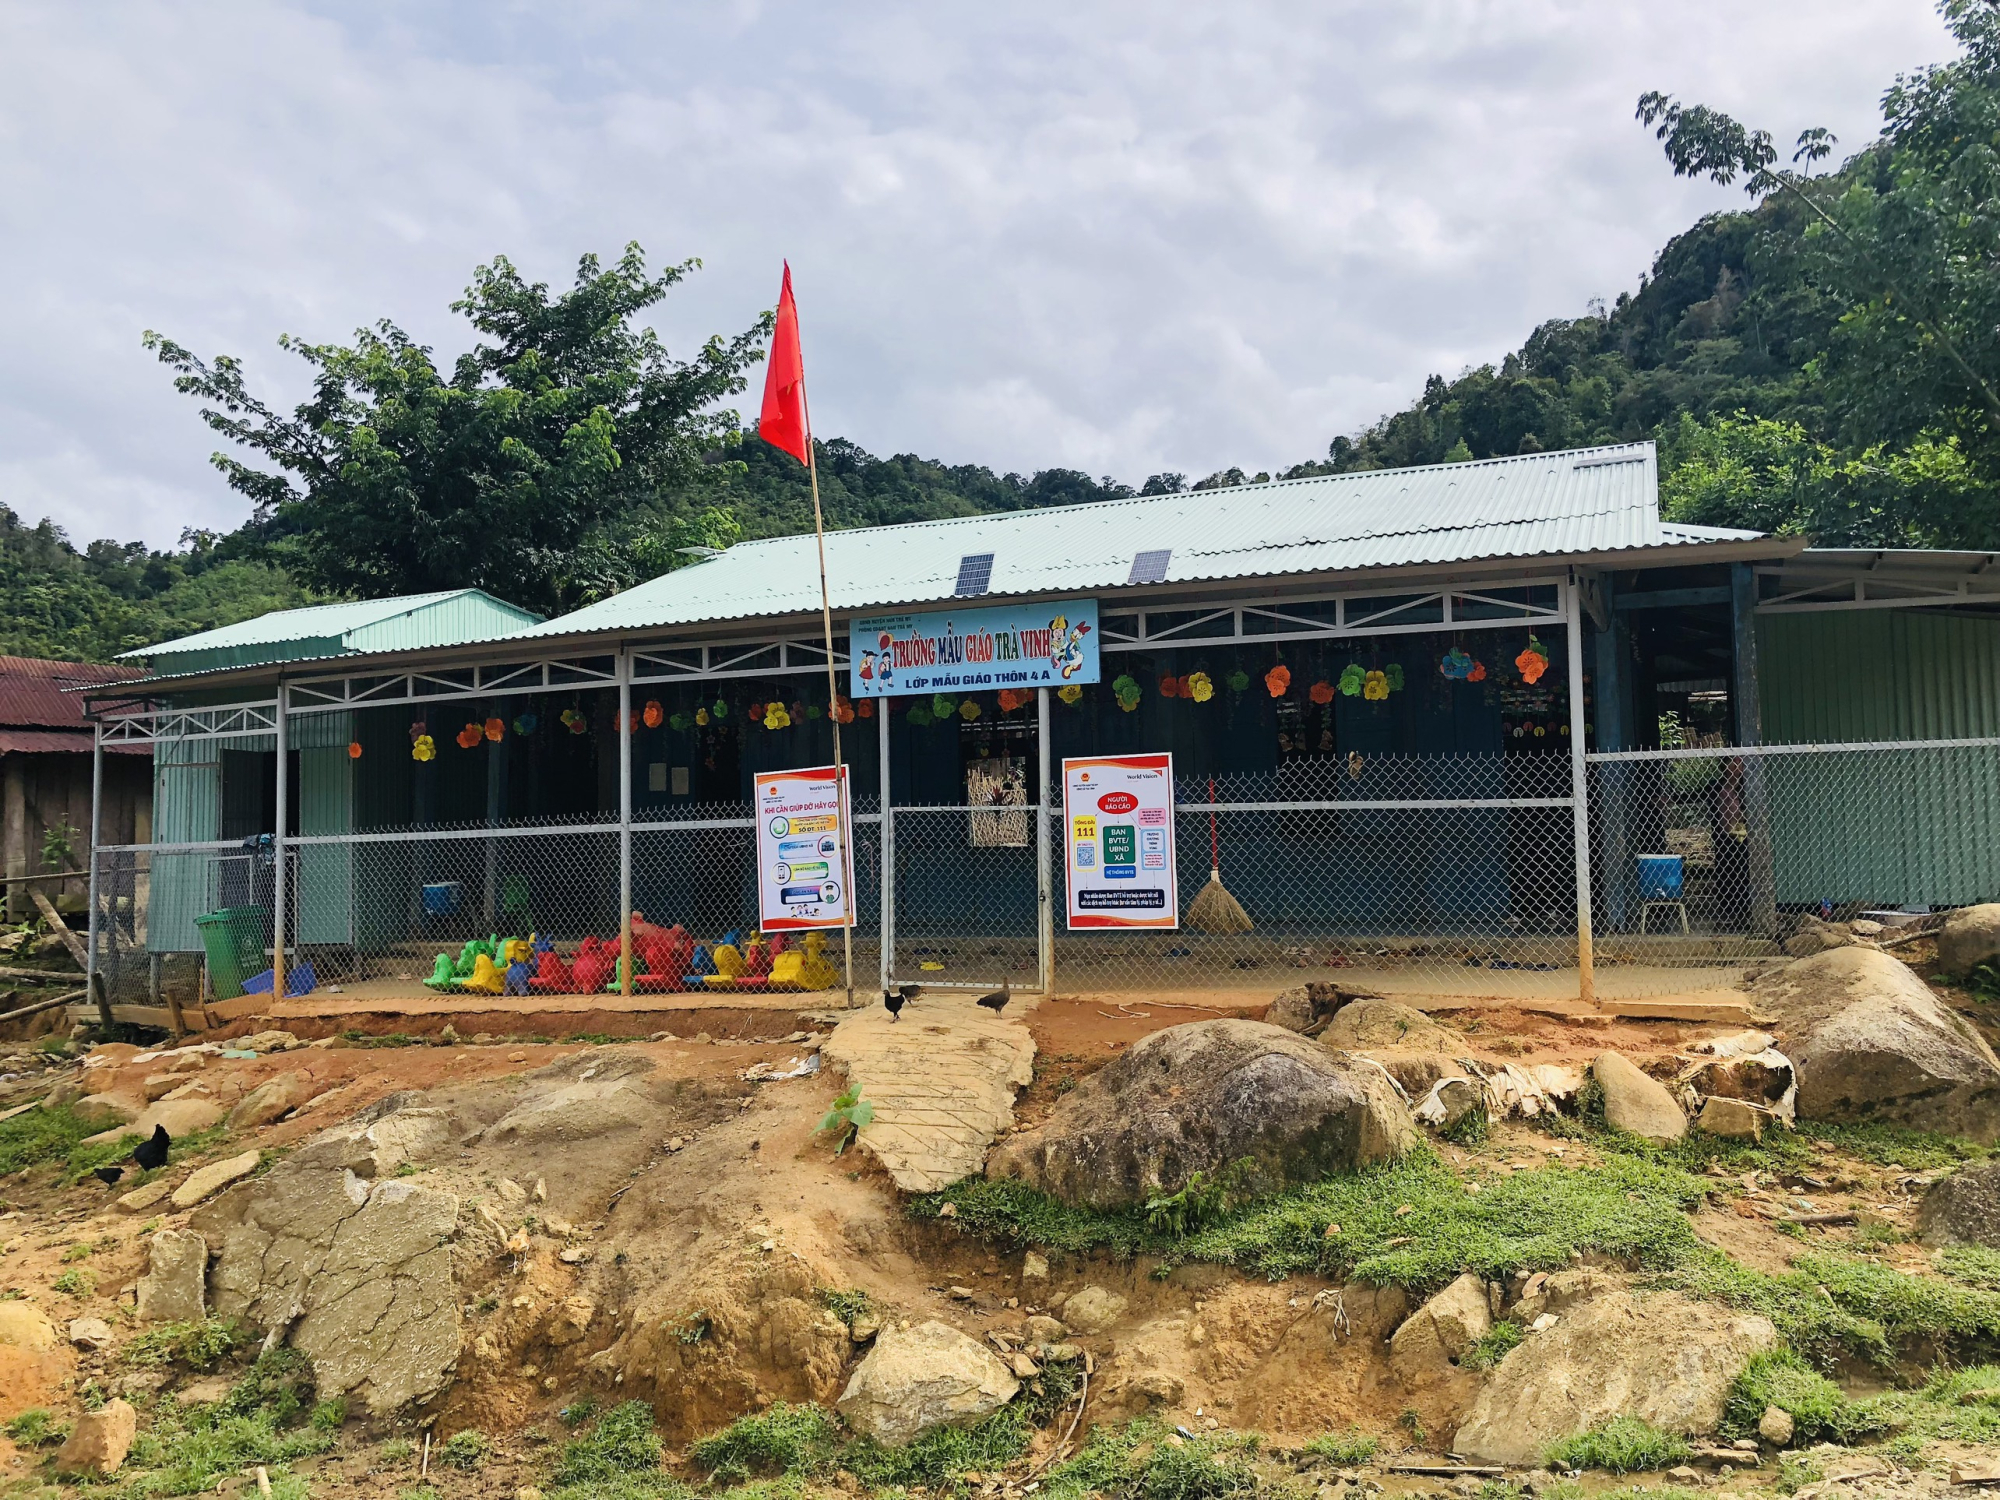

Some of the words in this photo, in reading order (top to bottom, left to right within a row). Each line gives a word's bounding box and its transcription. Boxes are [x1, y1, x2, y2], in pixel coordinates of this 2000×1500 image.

[891, 629, 936, 669] TRƯỜNG
[965, 626, 993, 663] GIÁO
[995, 623, 1020, 660] TRÀ
[1020, 629, 1052, 659] VINH
[906, 676, 929, 689] LỚP
[932, 673, 960, 687] MẪU
[963, 672, 991, 685] GIÁO
[994, 670, 1028, 683] THÔN
[1030, 671, 1039, 681] 4
[1041, 670, 1050, 680] A
[1107, 795, 1127, 803] NGƯỜI
[776, 804, 788, 813] CẦN
[789, 803, 803, 812] GIÚP
[804, 801, 813, 810] ĐỠ
[814, 801, 826, 809] HÃY
[1104, 802, 1117, 810] BÁO
[1117, 802, 1131, 810] CÁO
[1077, 827, 1094, 837] 111
[1108, 836, 1129, 844] BVTE/
[1114, 853, 1125, 861] XÃ
